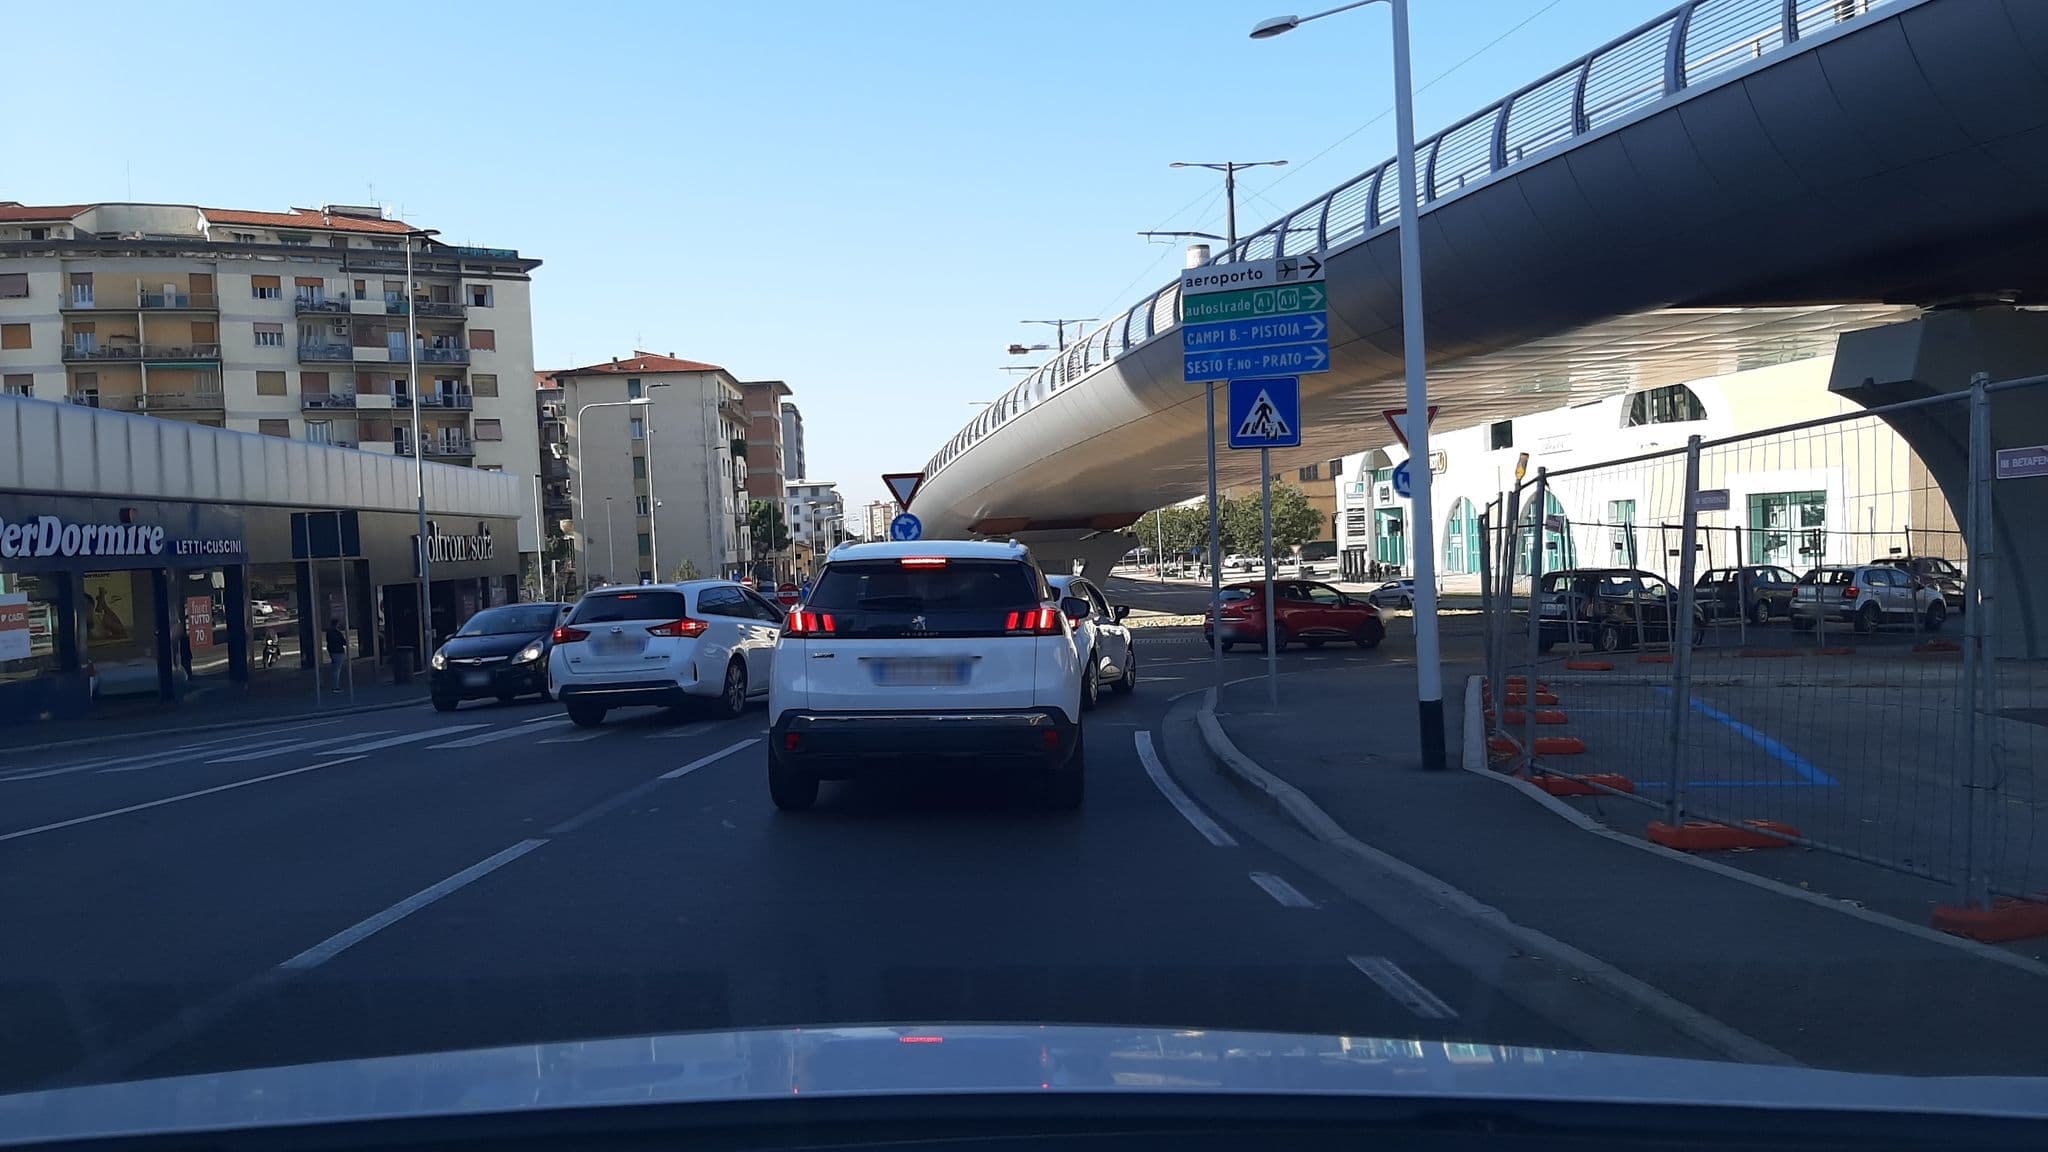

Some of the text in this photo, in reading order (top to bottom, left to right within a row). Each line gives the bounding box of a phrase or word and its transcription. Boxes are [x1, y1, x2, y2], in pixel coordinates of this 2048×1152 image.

[1185, 268, 1263, 288] aeroporto
[1185, 299, 1251, 317] autostrade
[1186, 330, 1225, 346] CAMPI
[1229, 328, 1241, 342] B.
[1251, 322, 1301, 340] PISTOIA
[1186, 360, 1223, 375] SESTO
[1262, 351, 1302, 369] PRATO
[0, 515, 165, 558] erDormire
